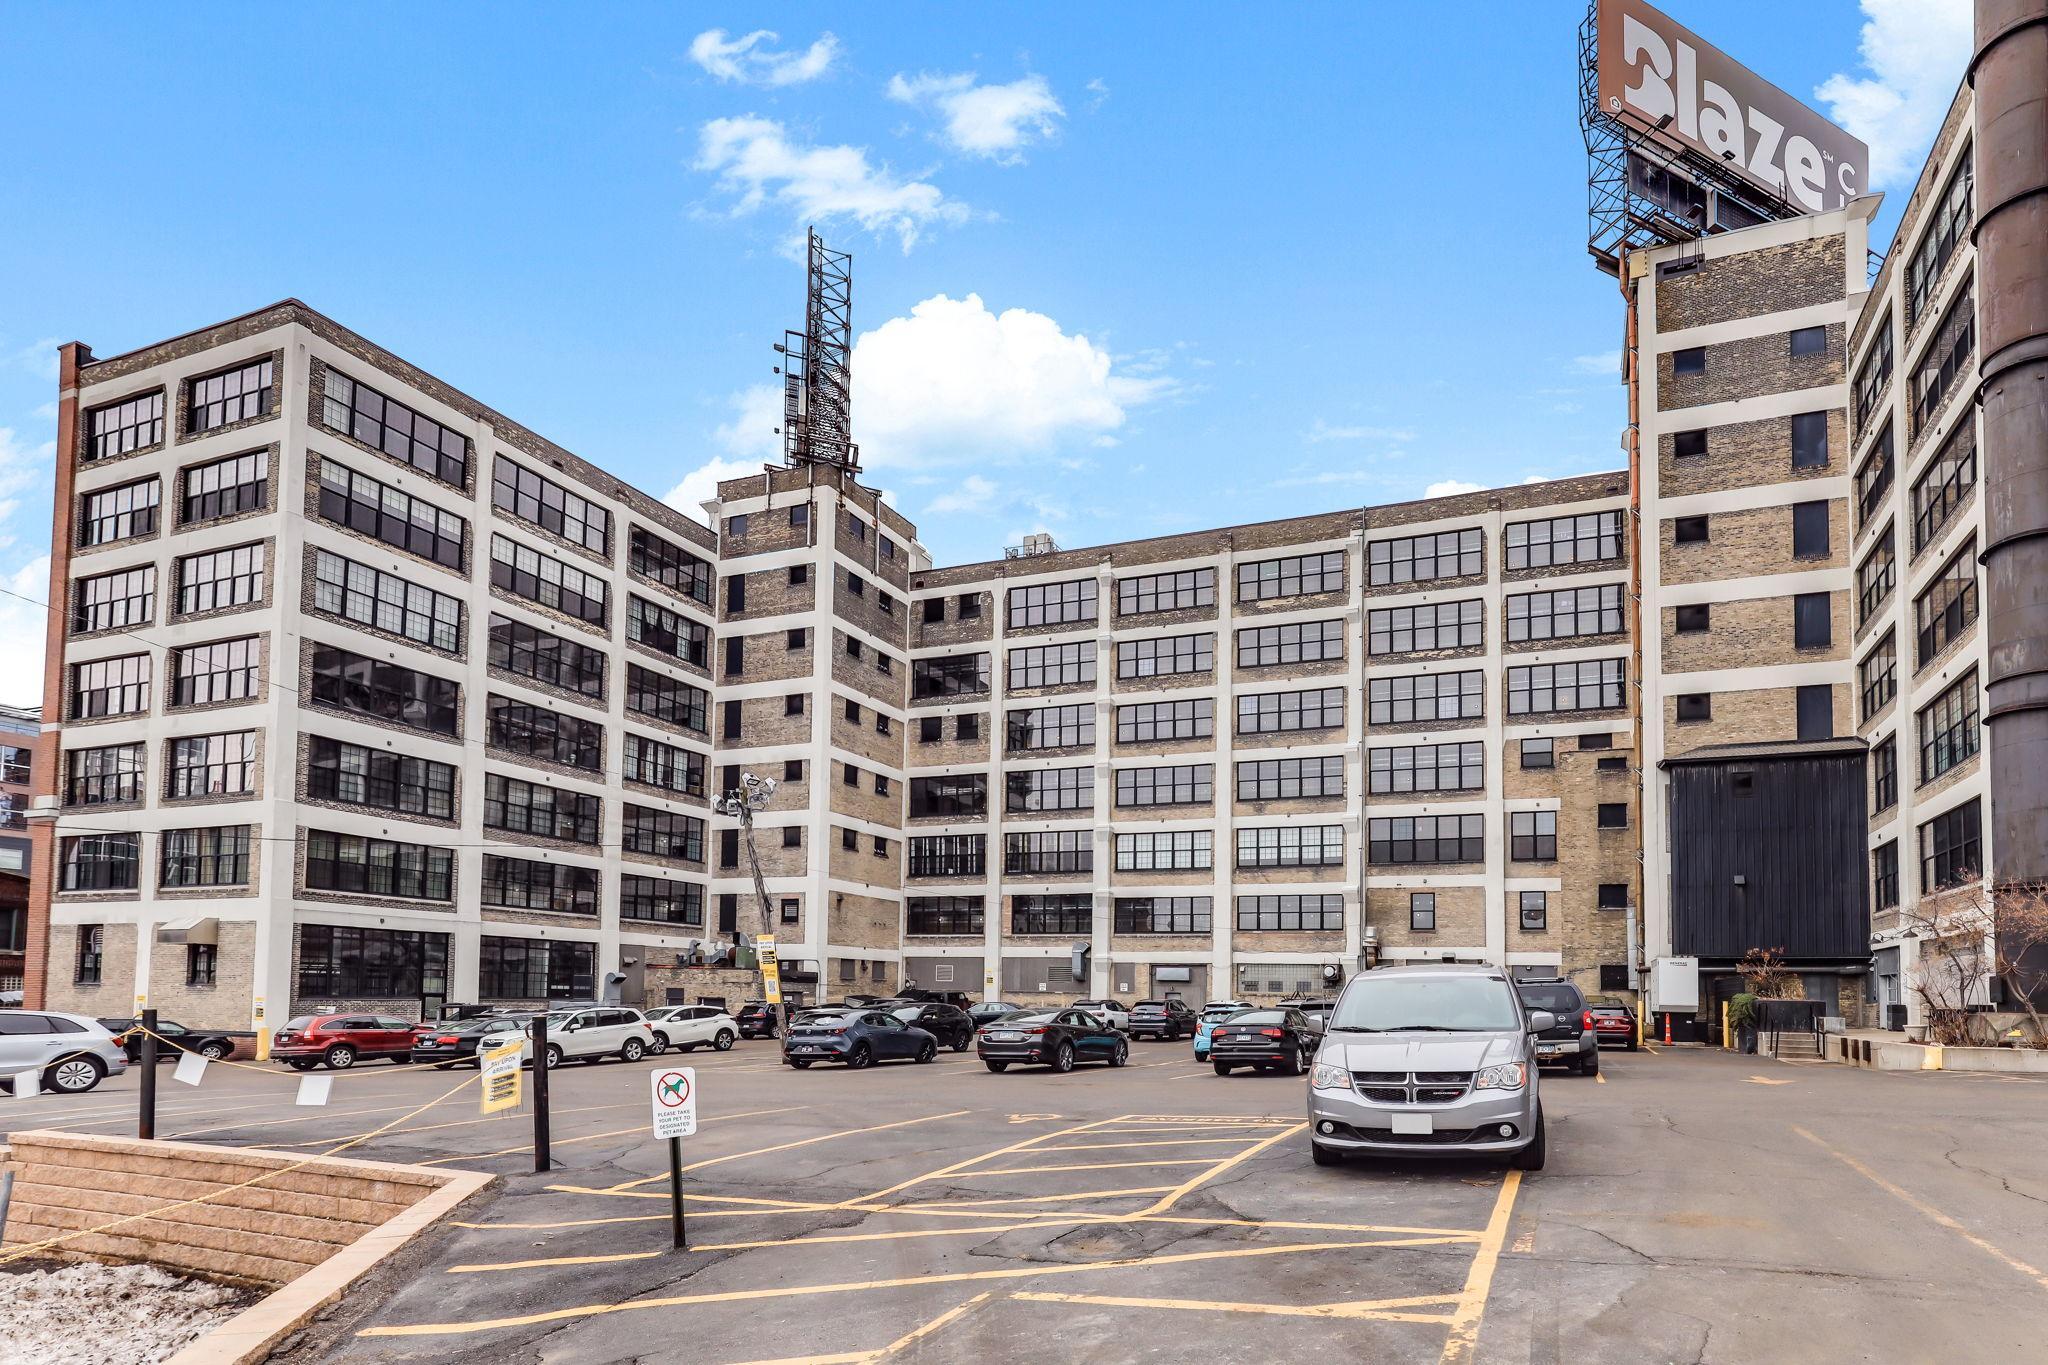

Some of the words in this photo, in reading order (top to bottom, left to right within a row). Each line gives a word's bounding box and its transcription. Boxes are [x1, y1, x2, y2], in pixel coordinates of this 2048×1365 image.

[1623, 13, 1826, 212] Blaze
[1822, 150, 1834, 163] SM
[659, 1121, 690, 1130] DESIGNATED
